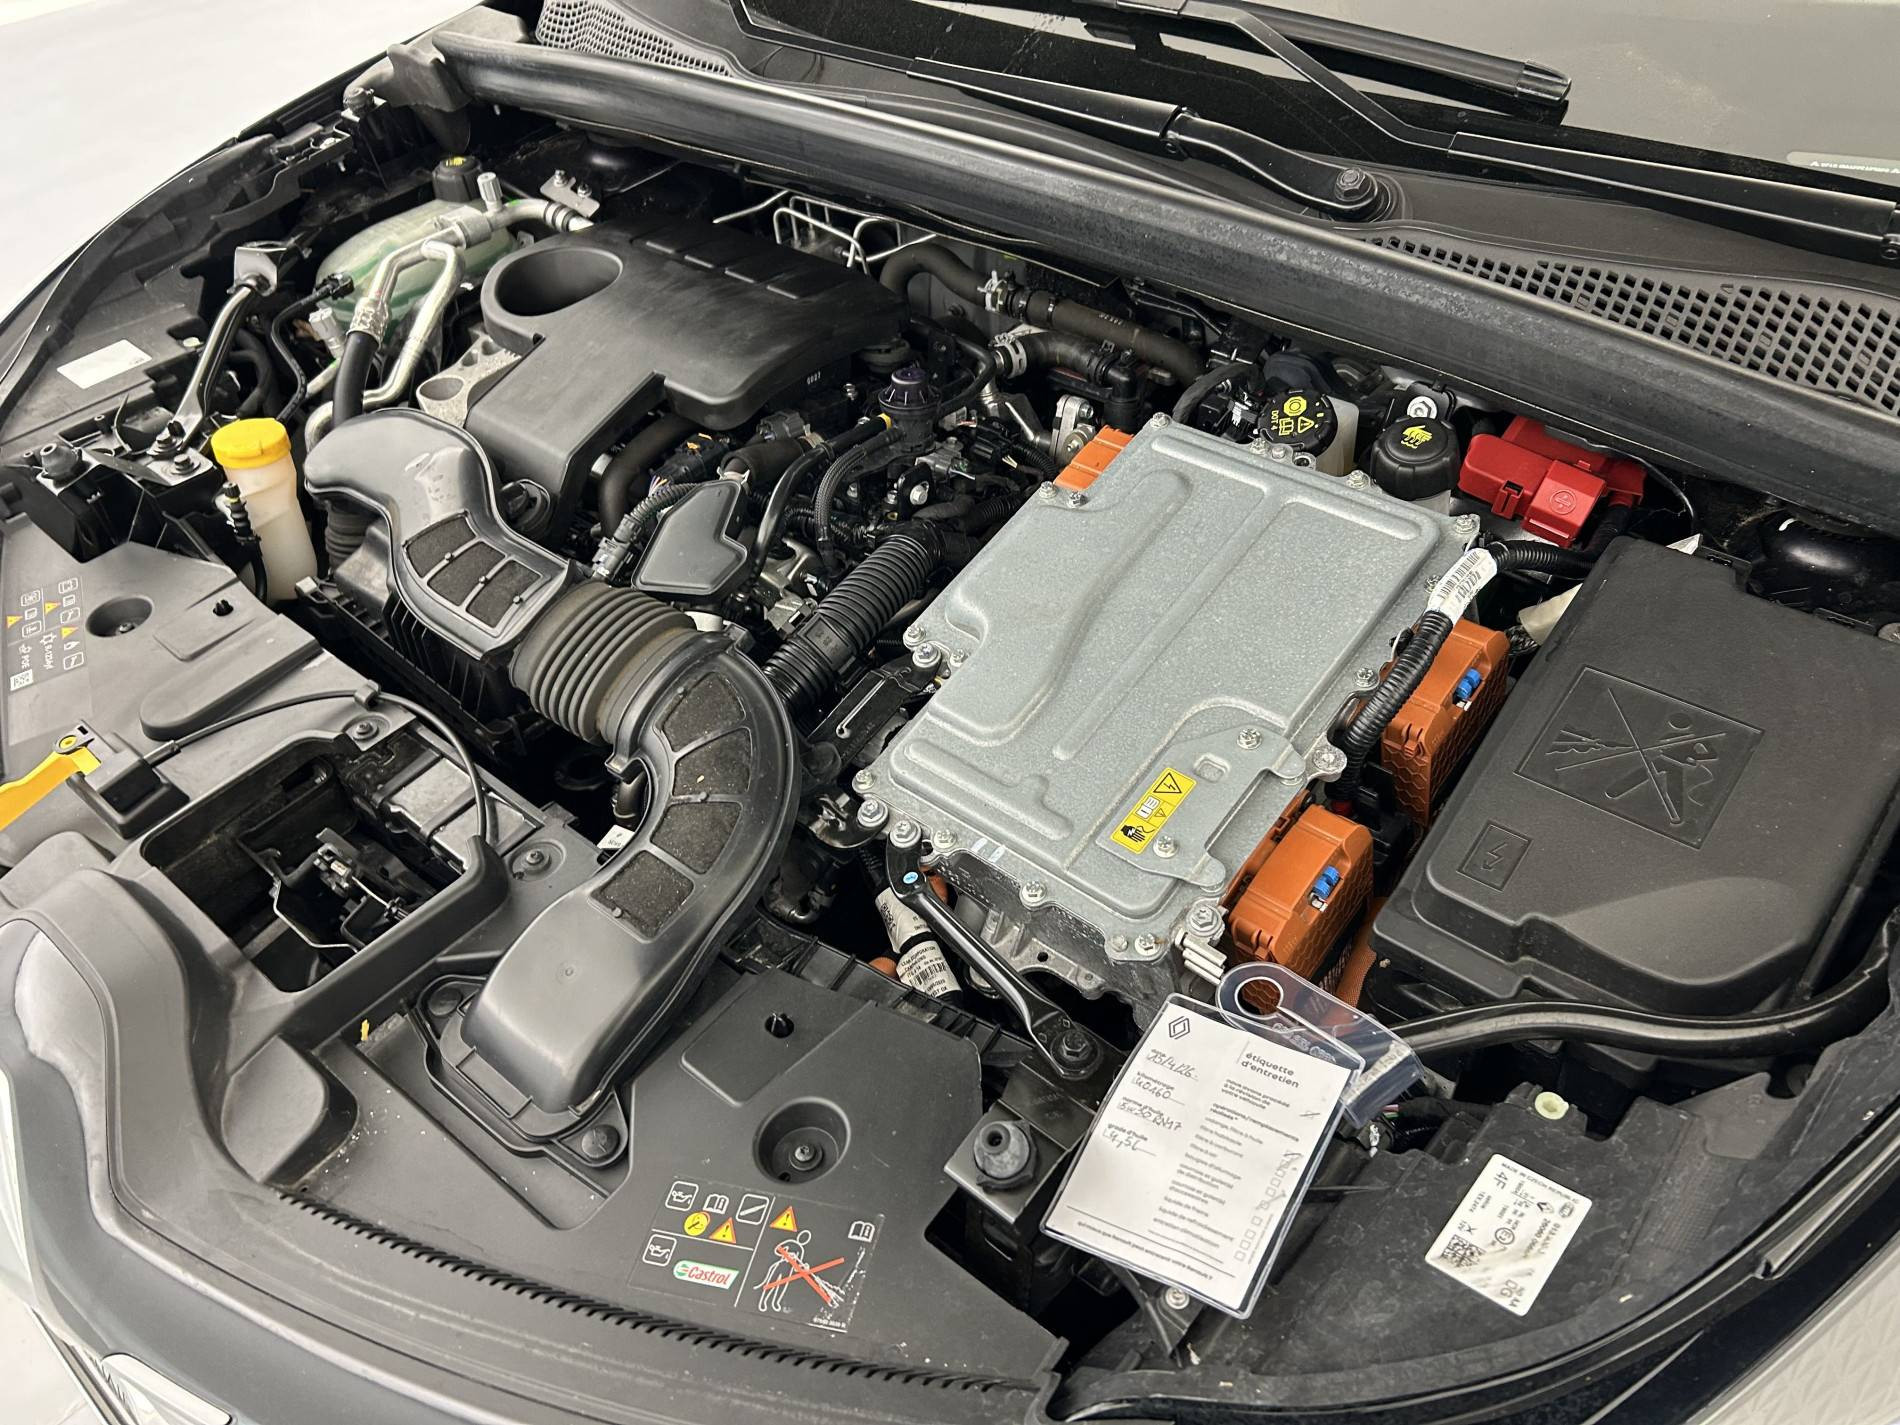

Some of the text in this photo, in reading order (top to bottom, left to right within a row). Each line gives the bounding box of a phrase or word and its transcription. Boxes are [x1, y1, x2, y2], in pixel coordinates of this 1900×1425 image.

[1271, 410, 1279, 424] DOT
[1246, 1053, 1295, 1077] étiquette
[1493, 1172, 1508, 1189] 4F
[688, 1266, 731, 1285] Castrol
